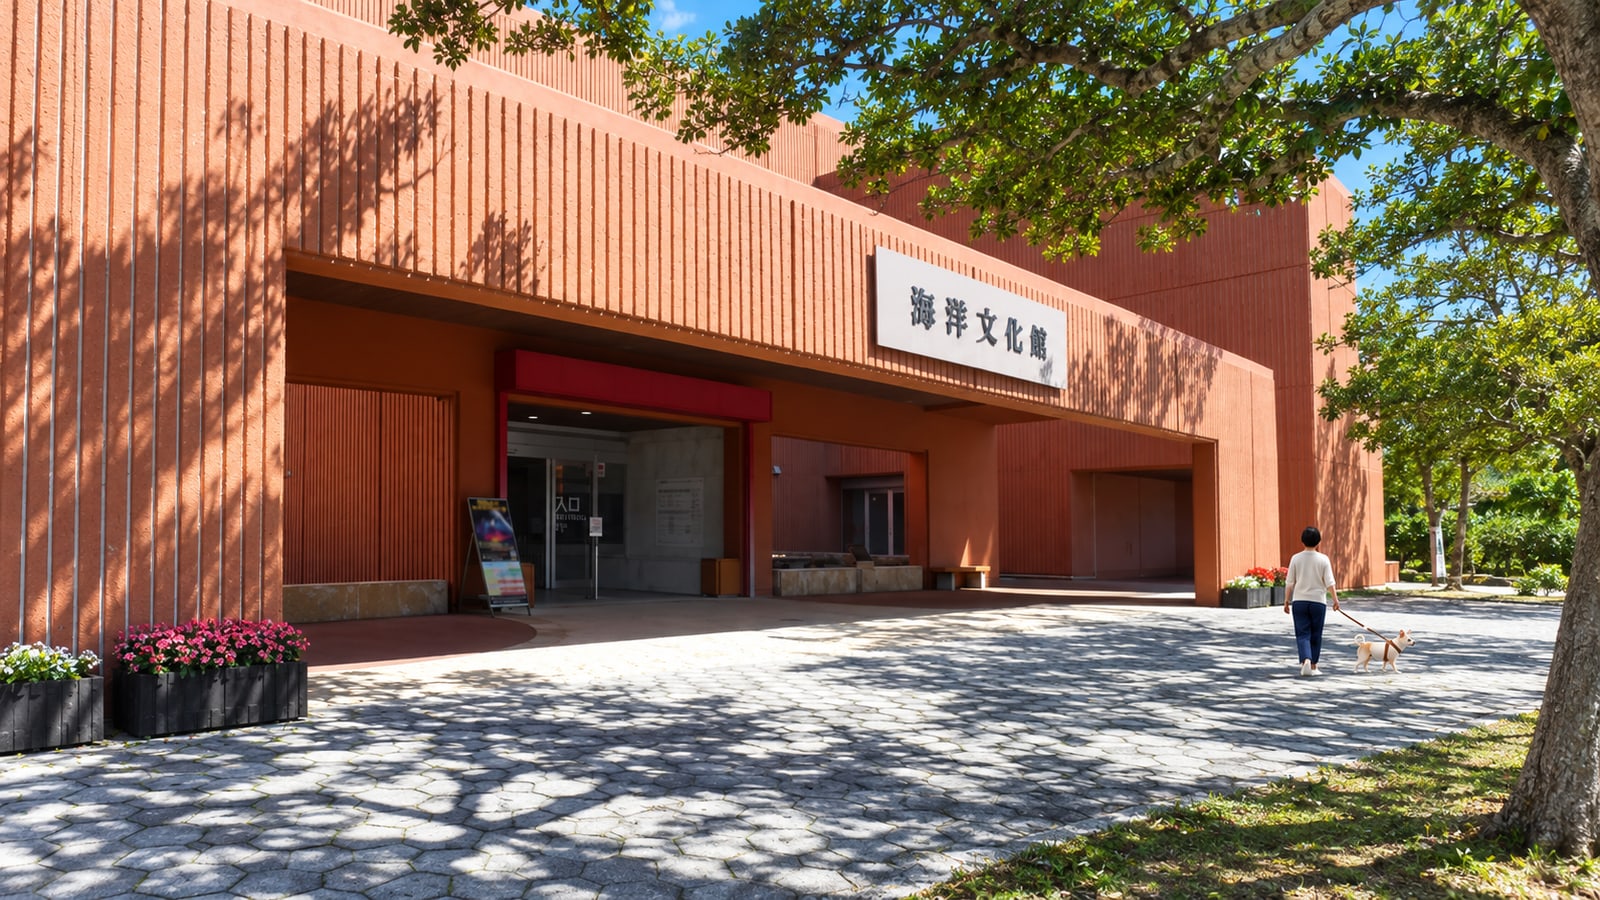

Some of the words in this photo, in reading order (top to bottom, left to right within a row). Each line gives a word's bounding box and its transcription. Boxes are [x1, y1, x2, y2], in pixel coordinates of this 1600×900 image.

[910, 285, 1048, 361] 海洋文化館
[555, 496, 580, 512] 入口
